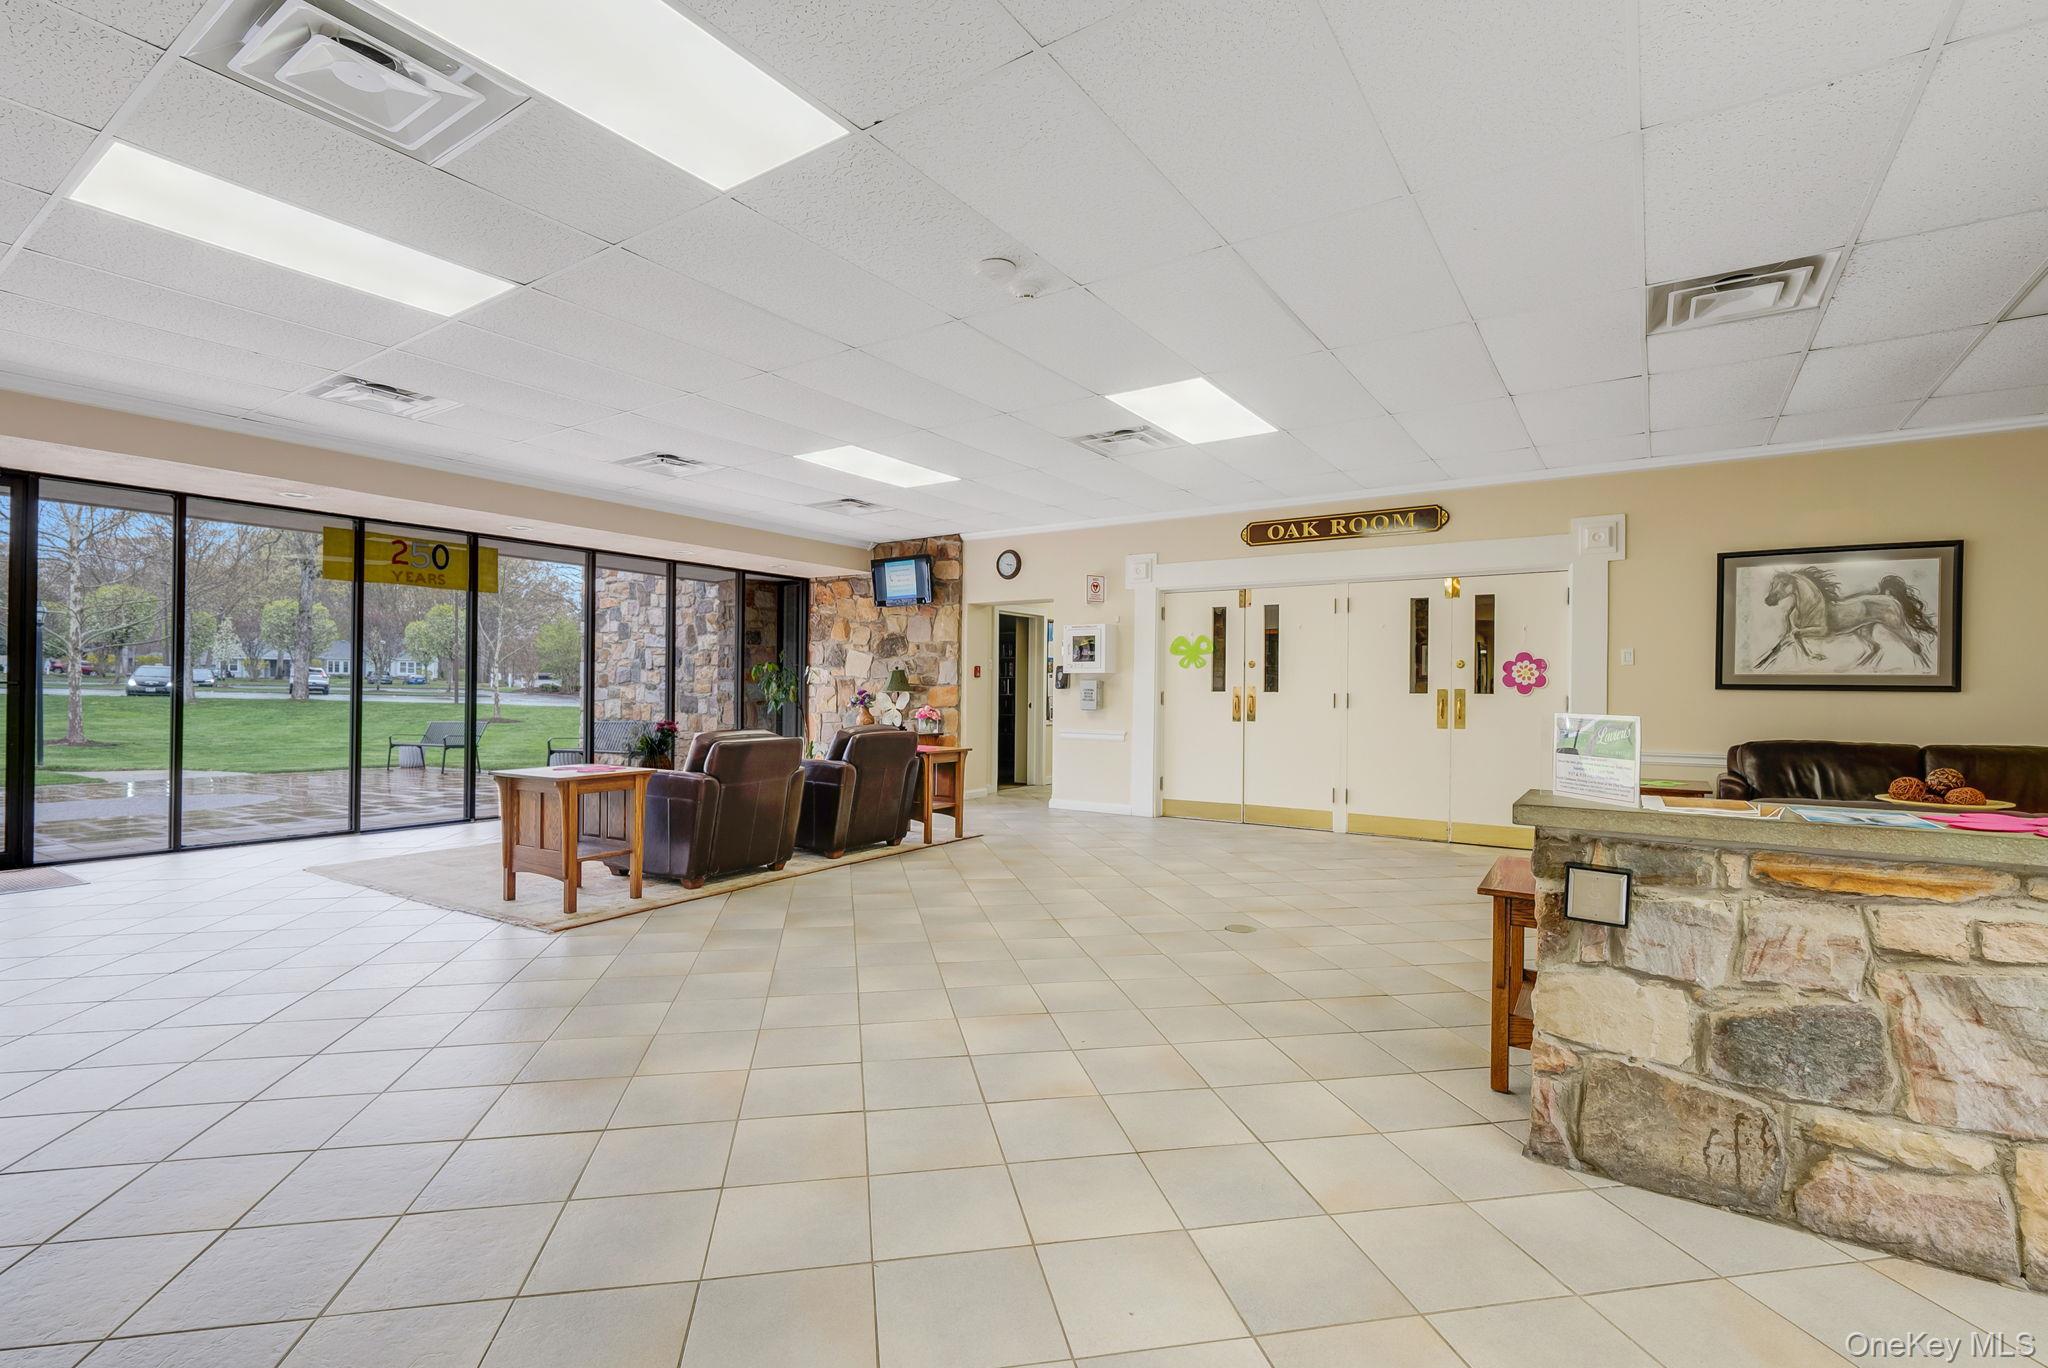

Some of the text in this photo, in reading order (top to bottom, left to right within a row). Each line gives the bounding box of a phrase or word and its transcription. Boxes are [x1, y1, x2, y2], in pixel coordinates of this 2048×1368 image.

[1267, 511, 1416, 540] OAK ROOM
[391, 539, 450, 571] 250
[392, 570, 446, 585] YEARS
